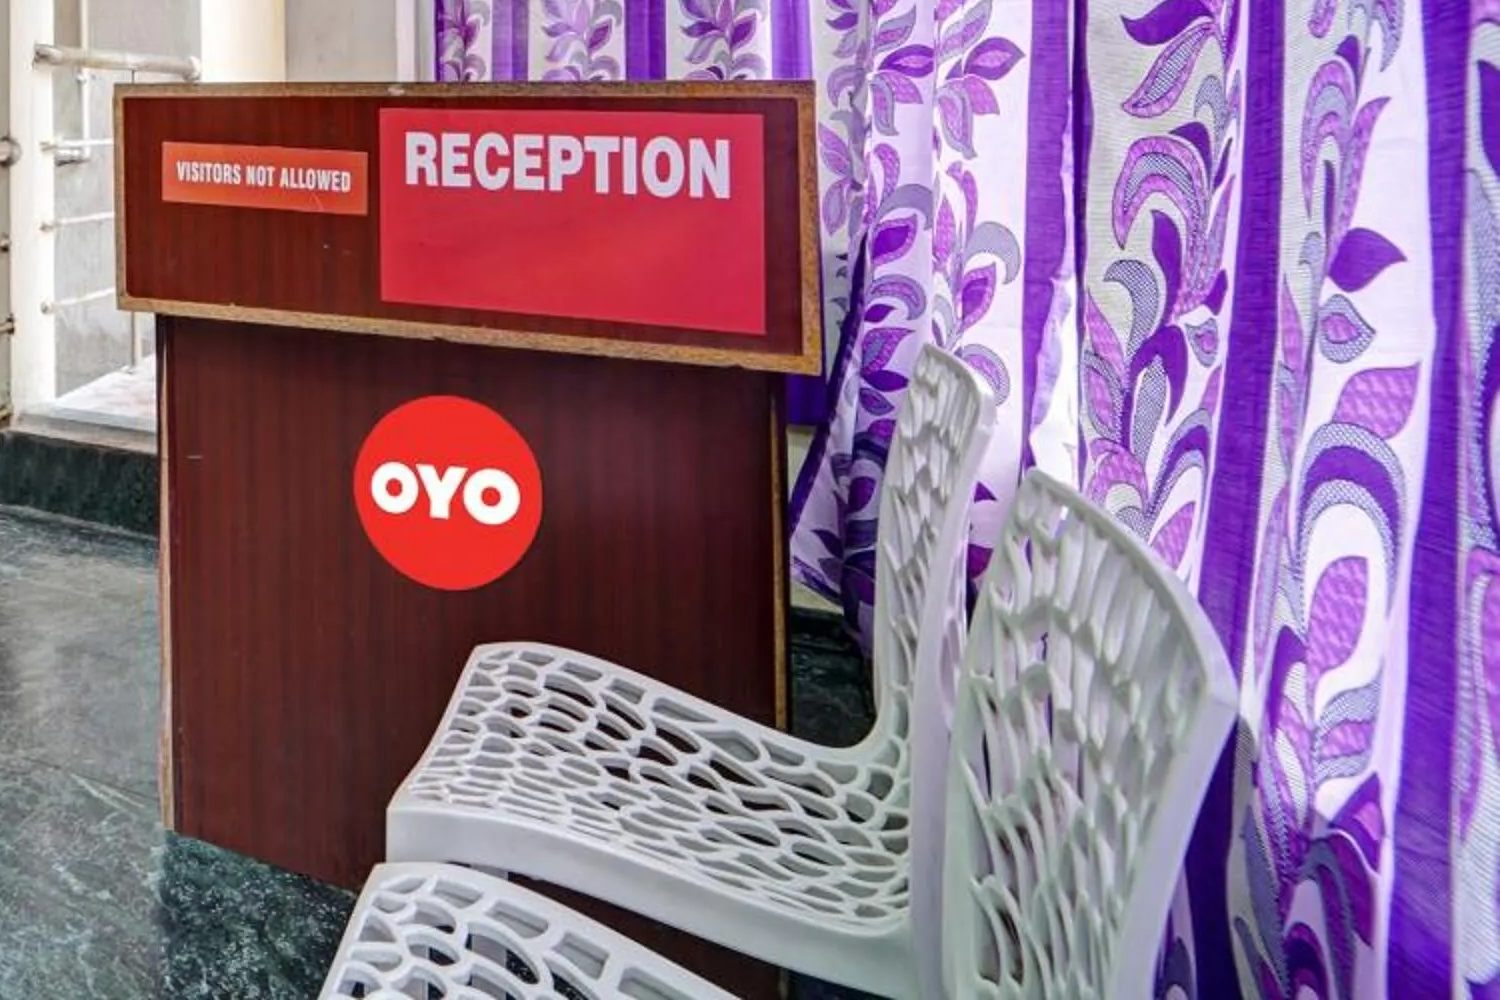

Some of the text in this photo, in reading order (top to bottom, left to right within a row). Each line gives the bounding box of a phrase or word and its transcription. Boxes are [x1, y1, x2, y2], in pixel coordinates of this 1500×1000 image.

[176, 160, 351, 193] VISITORS NOT ALLOWED
[406, 133, 729, 198] RECEPTION
[372, 462, 520, 524] OYO
